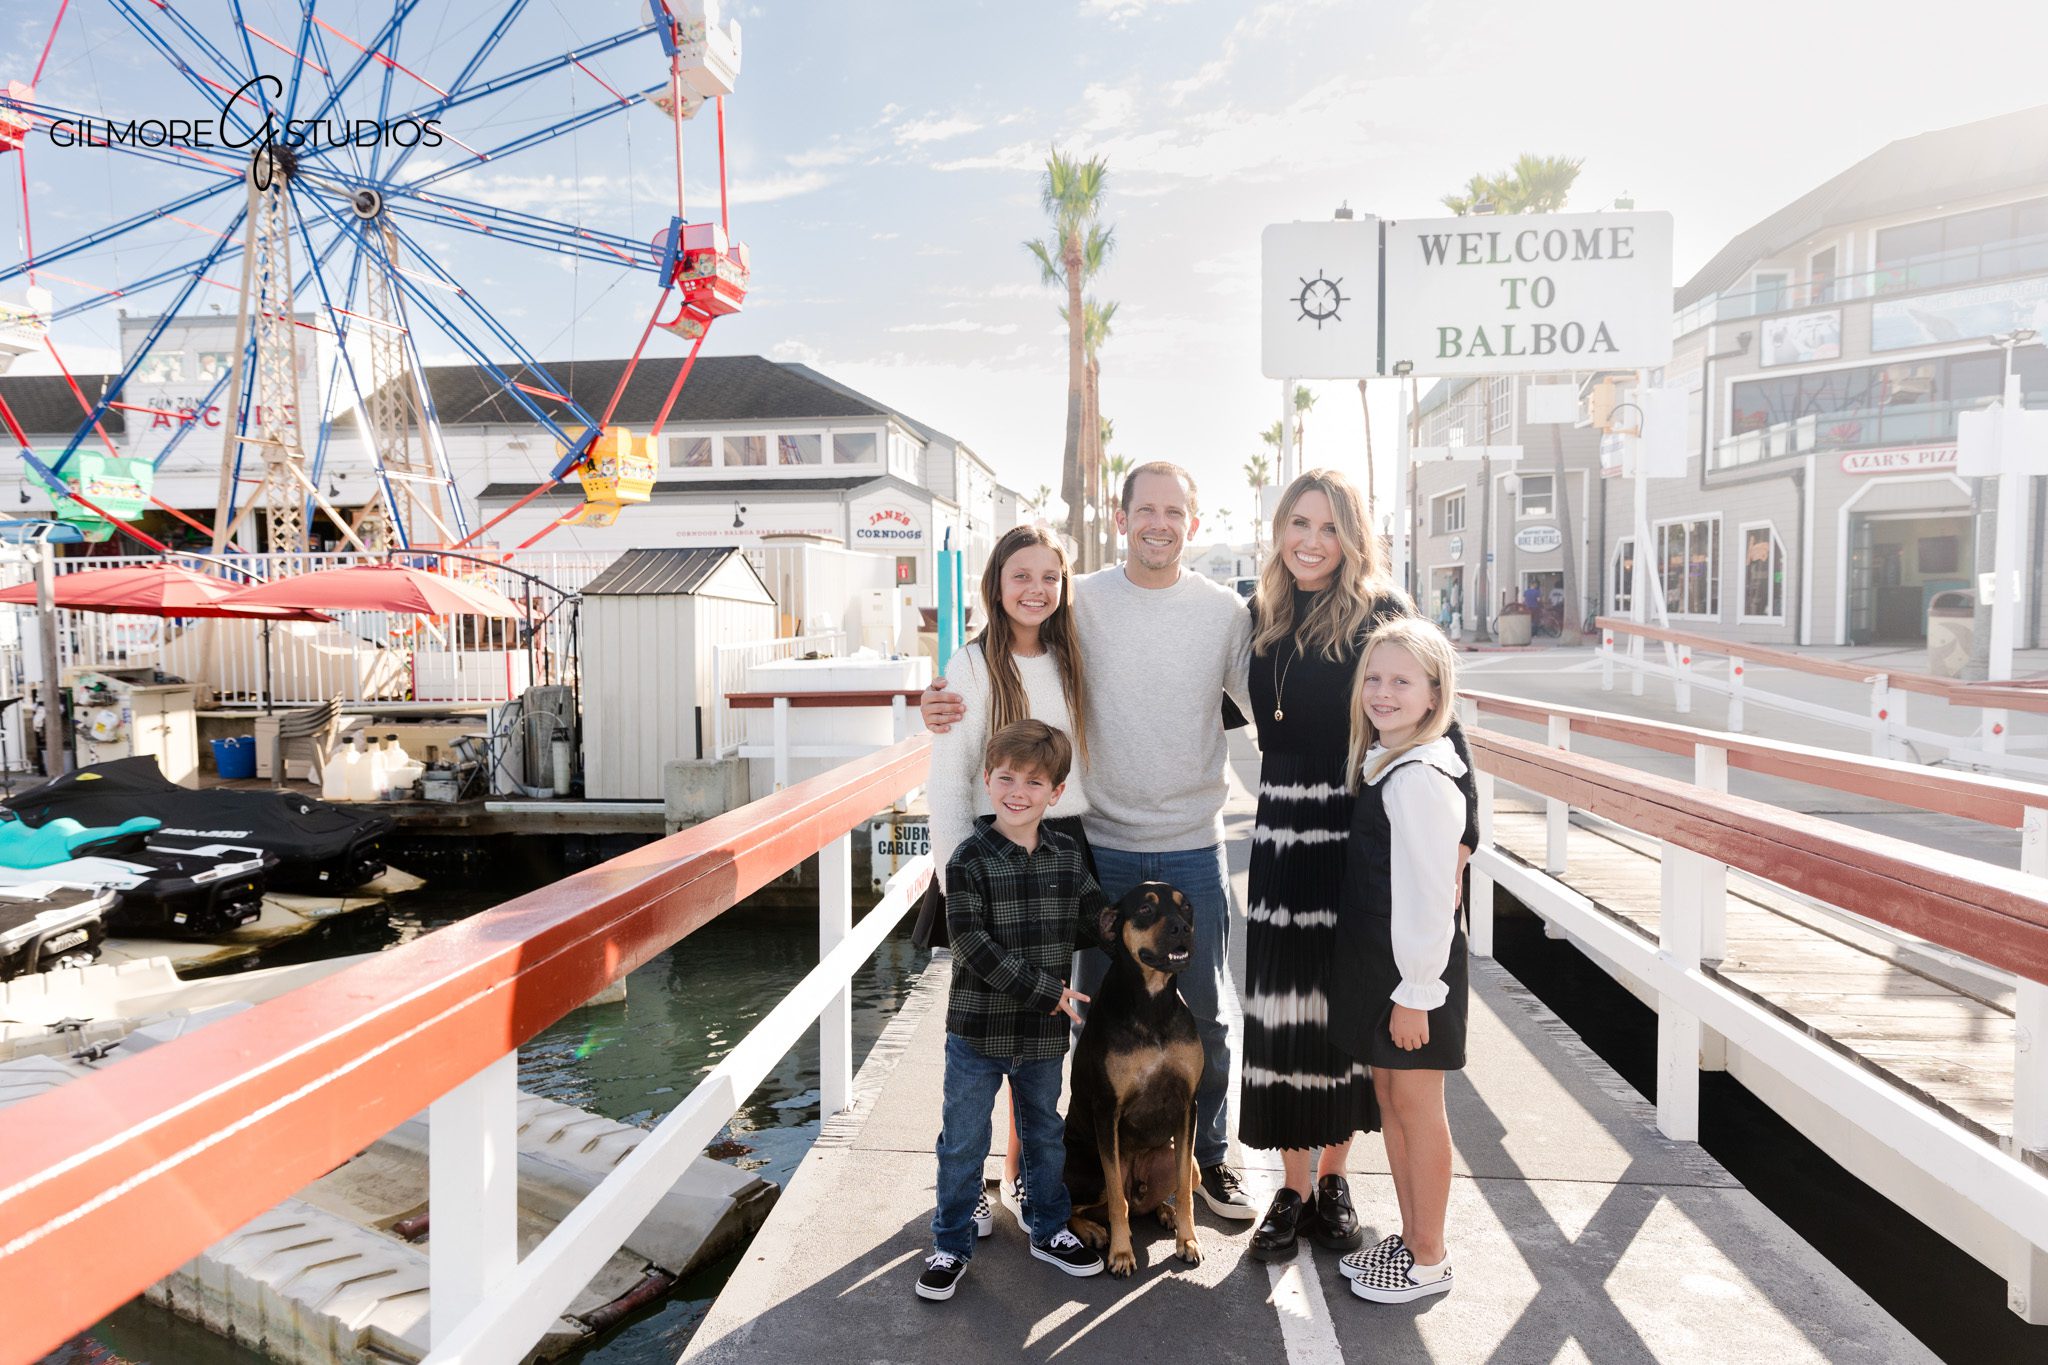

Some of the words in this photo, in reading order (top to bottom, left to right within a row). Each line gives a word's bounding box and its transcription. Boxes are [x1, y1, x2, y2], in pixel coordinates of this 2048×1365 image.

[1417, 226, 1635, 266] WELCOME
[1500, 276, 1556, 310] TO
[1435, 320, 1620, 359] BALBOA
[1850, 452, 1910, 468] AZAR'S
[869, 510, 911, 526] JANE'S
[857, 528, 922, 539] CORNDOGS
[878, 841, 918, 856] CABLE
